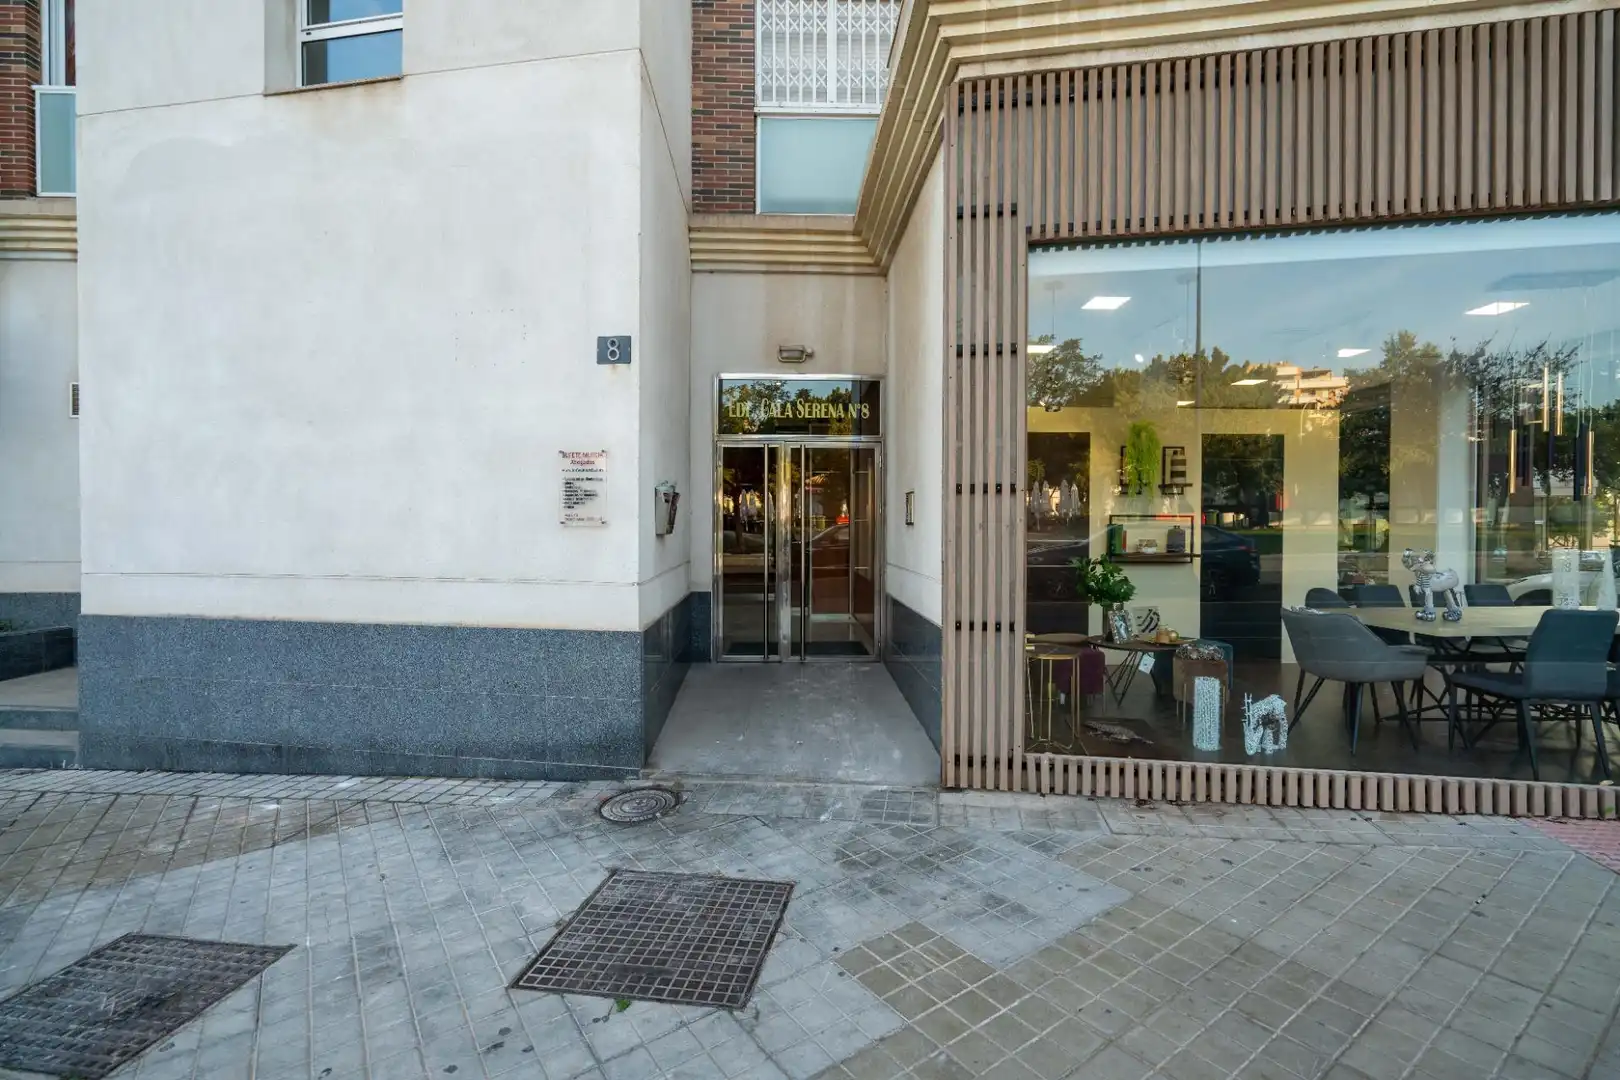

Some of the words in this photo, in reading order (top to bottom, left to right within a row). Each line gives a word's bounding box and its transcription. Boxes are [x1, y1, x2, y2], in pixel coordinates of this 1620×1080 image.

[607, 338, 619, 361] 8
[760, 398, 793, 419] CALA
[796, 399, 845, 418] SERENA
